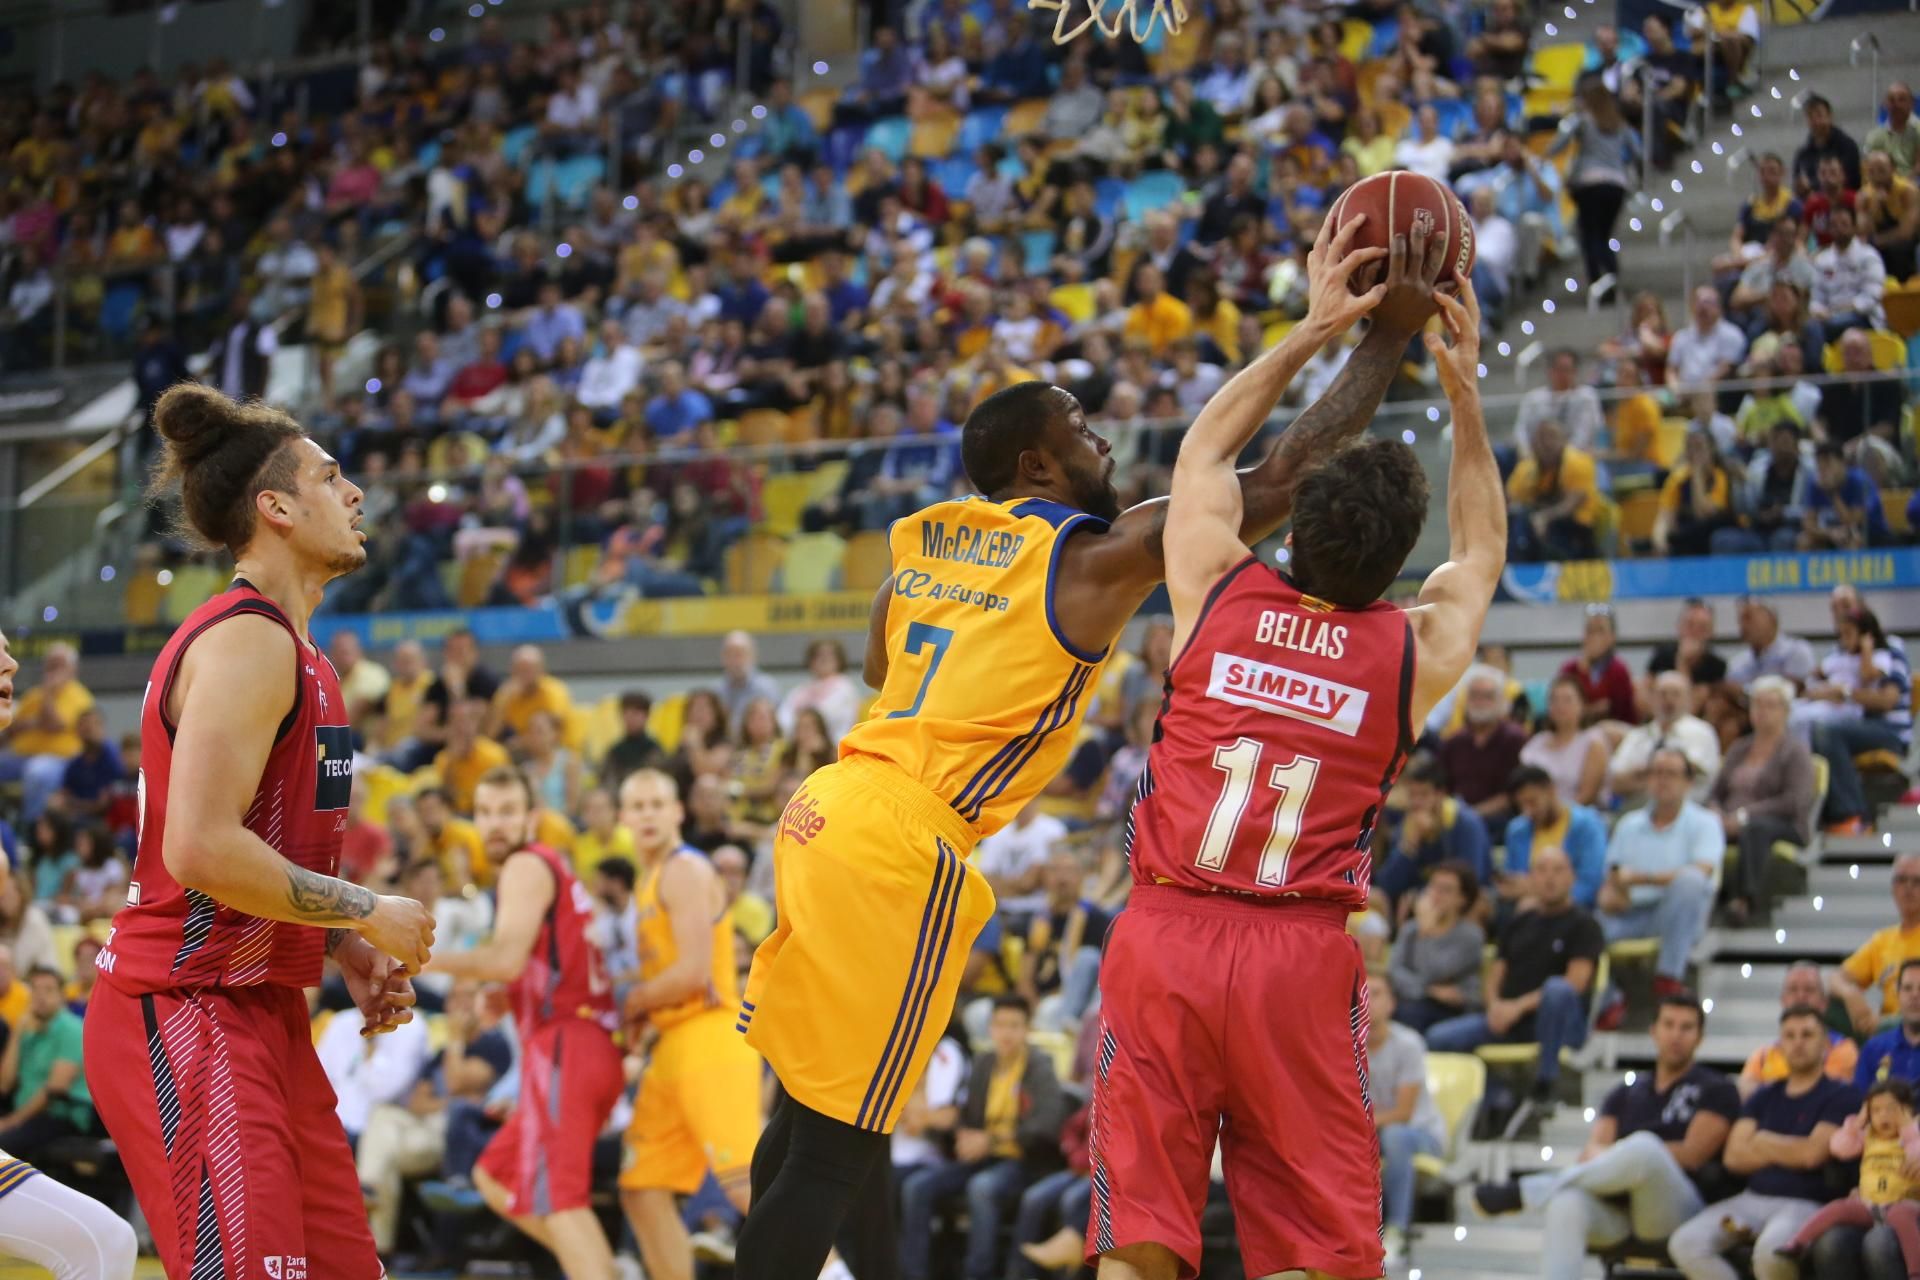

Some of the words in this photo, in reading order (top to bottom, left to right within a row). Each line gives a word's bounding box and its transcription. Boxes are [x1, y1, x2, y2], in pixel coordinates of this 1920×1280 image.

[922, 520, 1025, 569] McCALEBB
[1747, 558, 1799, 590] GRAN
[1808, 553, 1896, 587] CANARIA
[1255, 610, 1348, 660] BELLAS
[886, 620, 955, 720] 7
[1194, 736, 1322, 888] 11
